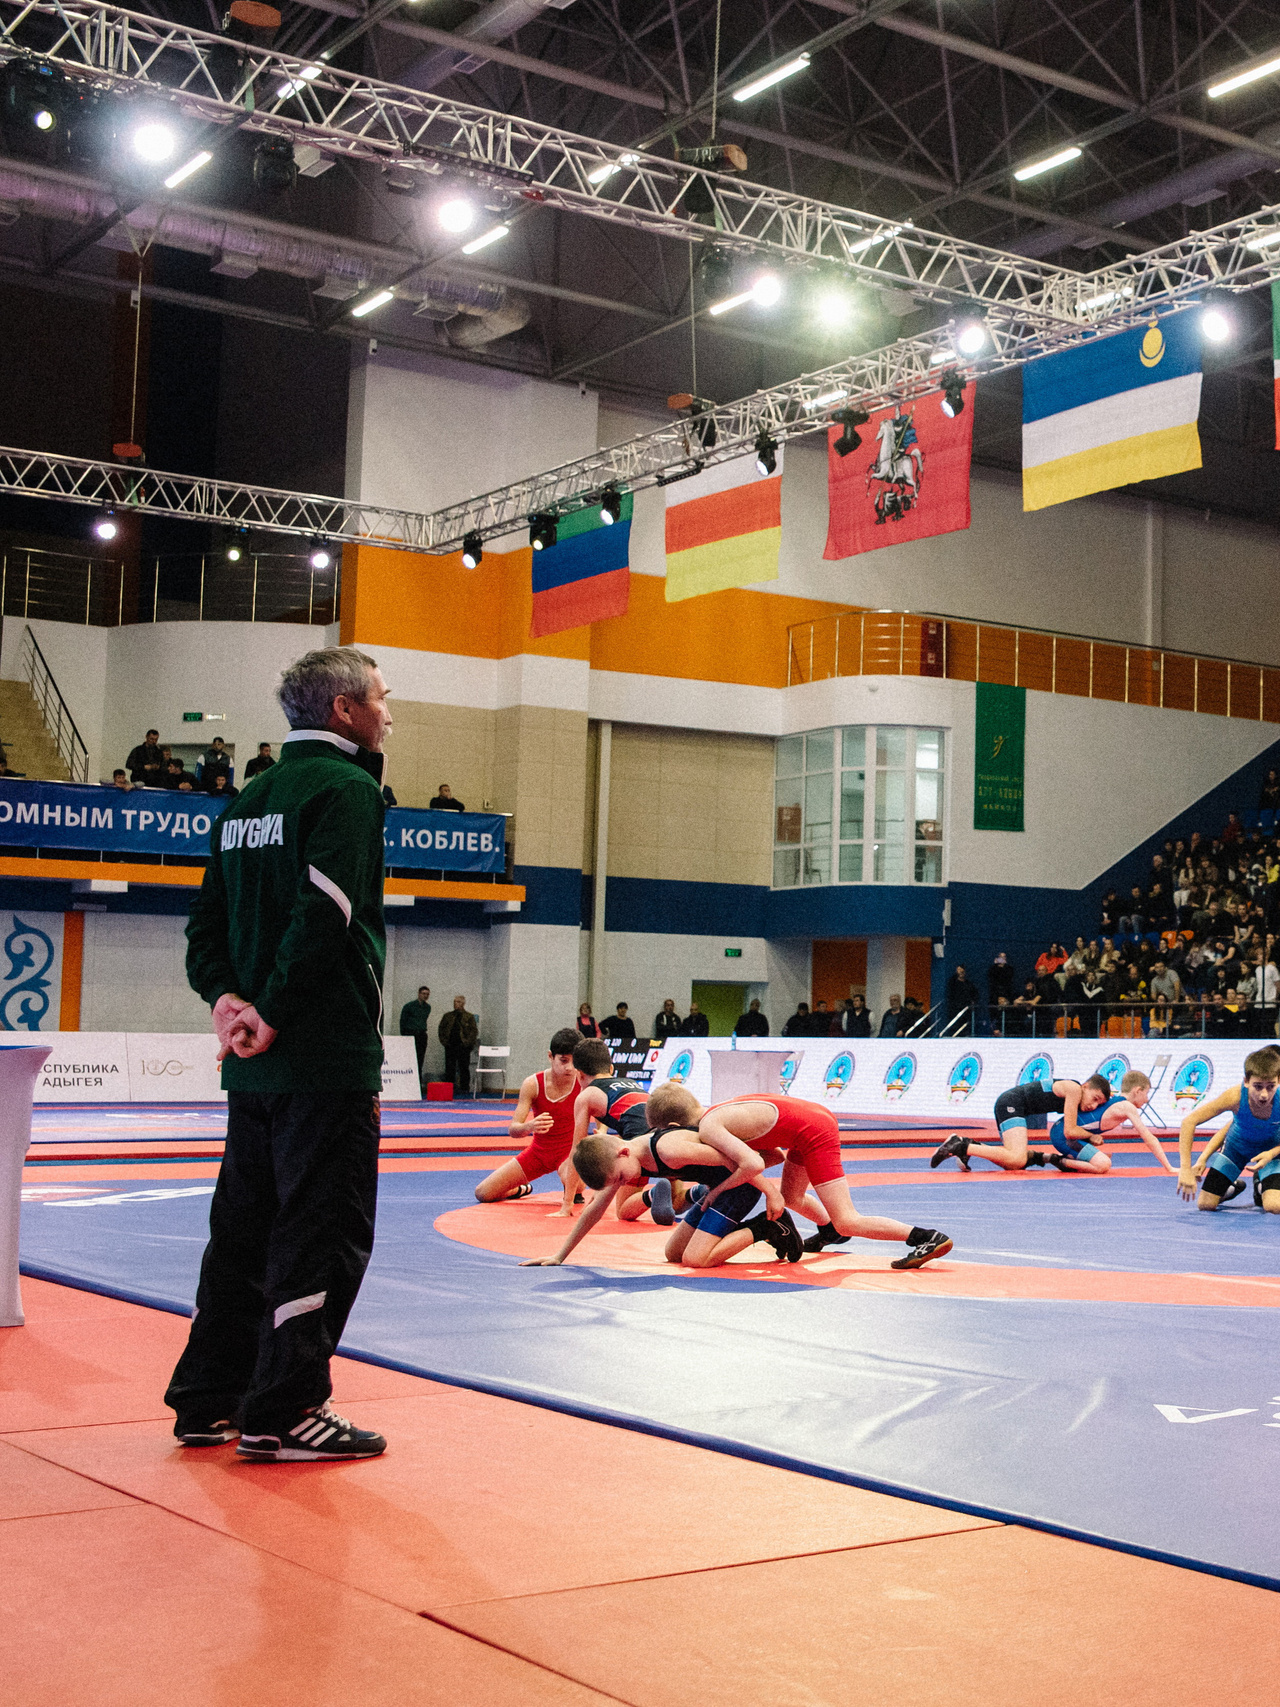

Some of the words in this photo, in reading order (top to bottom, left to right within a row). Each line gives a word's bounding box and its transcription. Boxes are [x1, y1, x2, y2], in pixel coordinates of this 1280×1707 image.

[122, 809, 219, 838] ТРУДО
[401, 828, 500, 853] КОБЛЕВ.
[39, 1063, 119, 1073] СПУБЛИКА
[43, 1077, 103, 1088] АДЫГЕЯ
